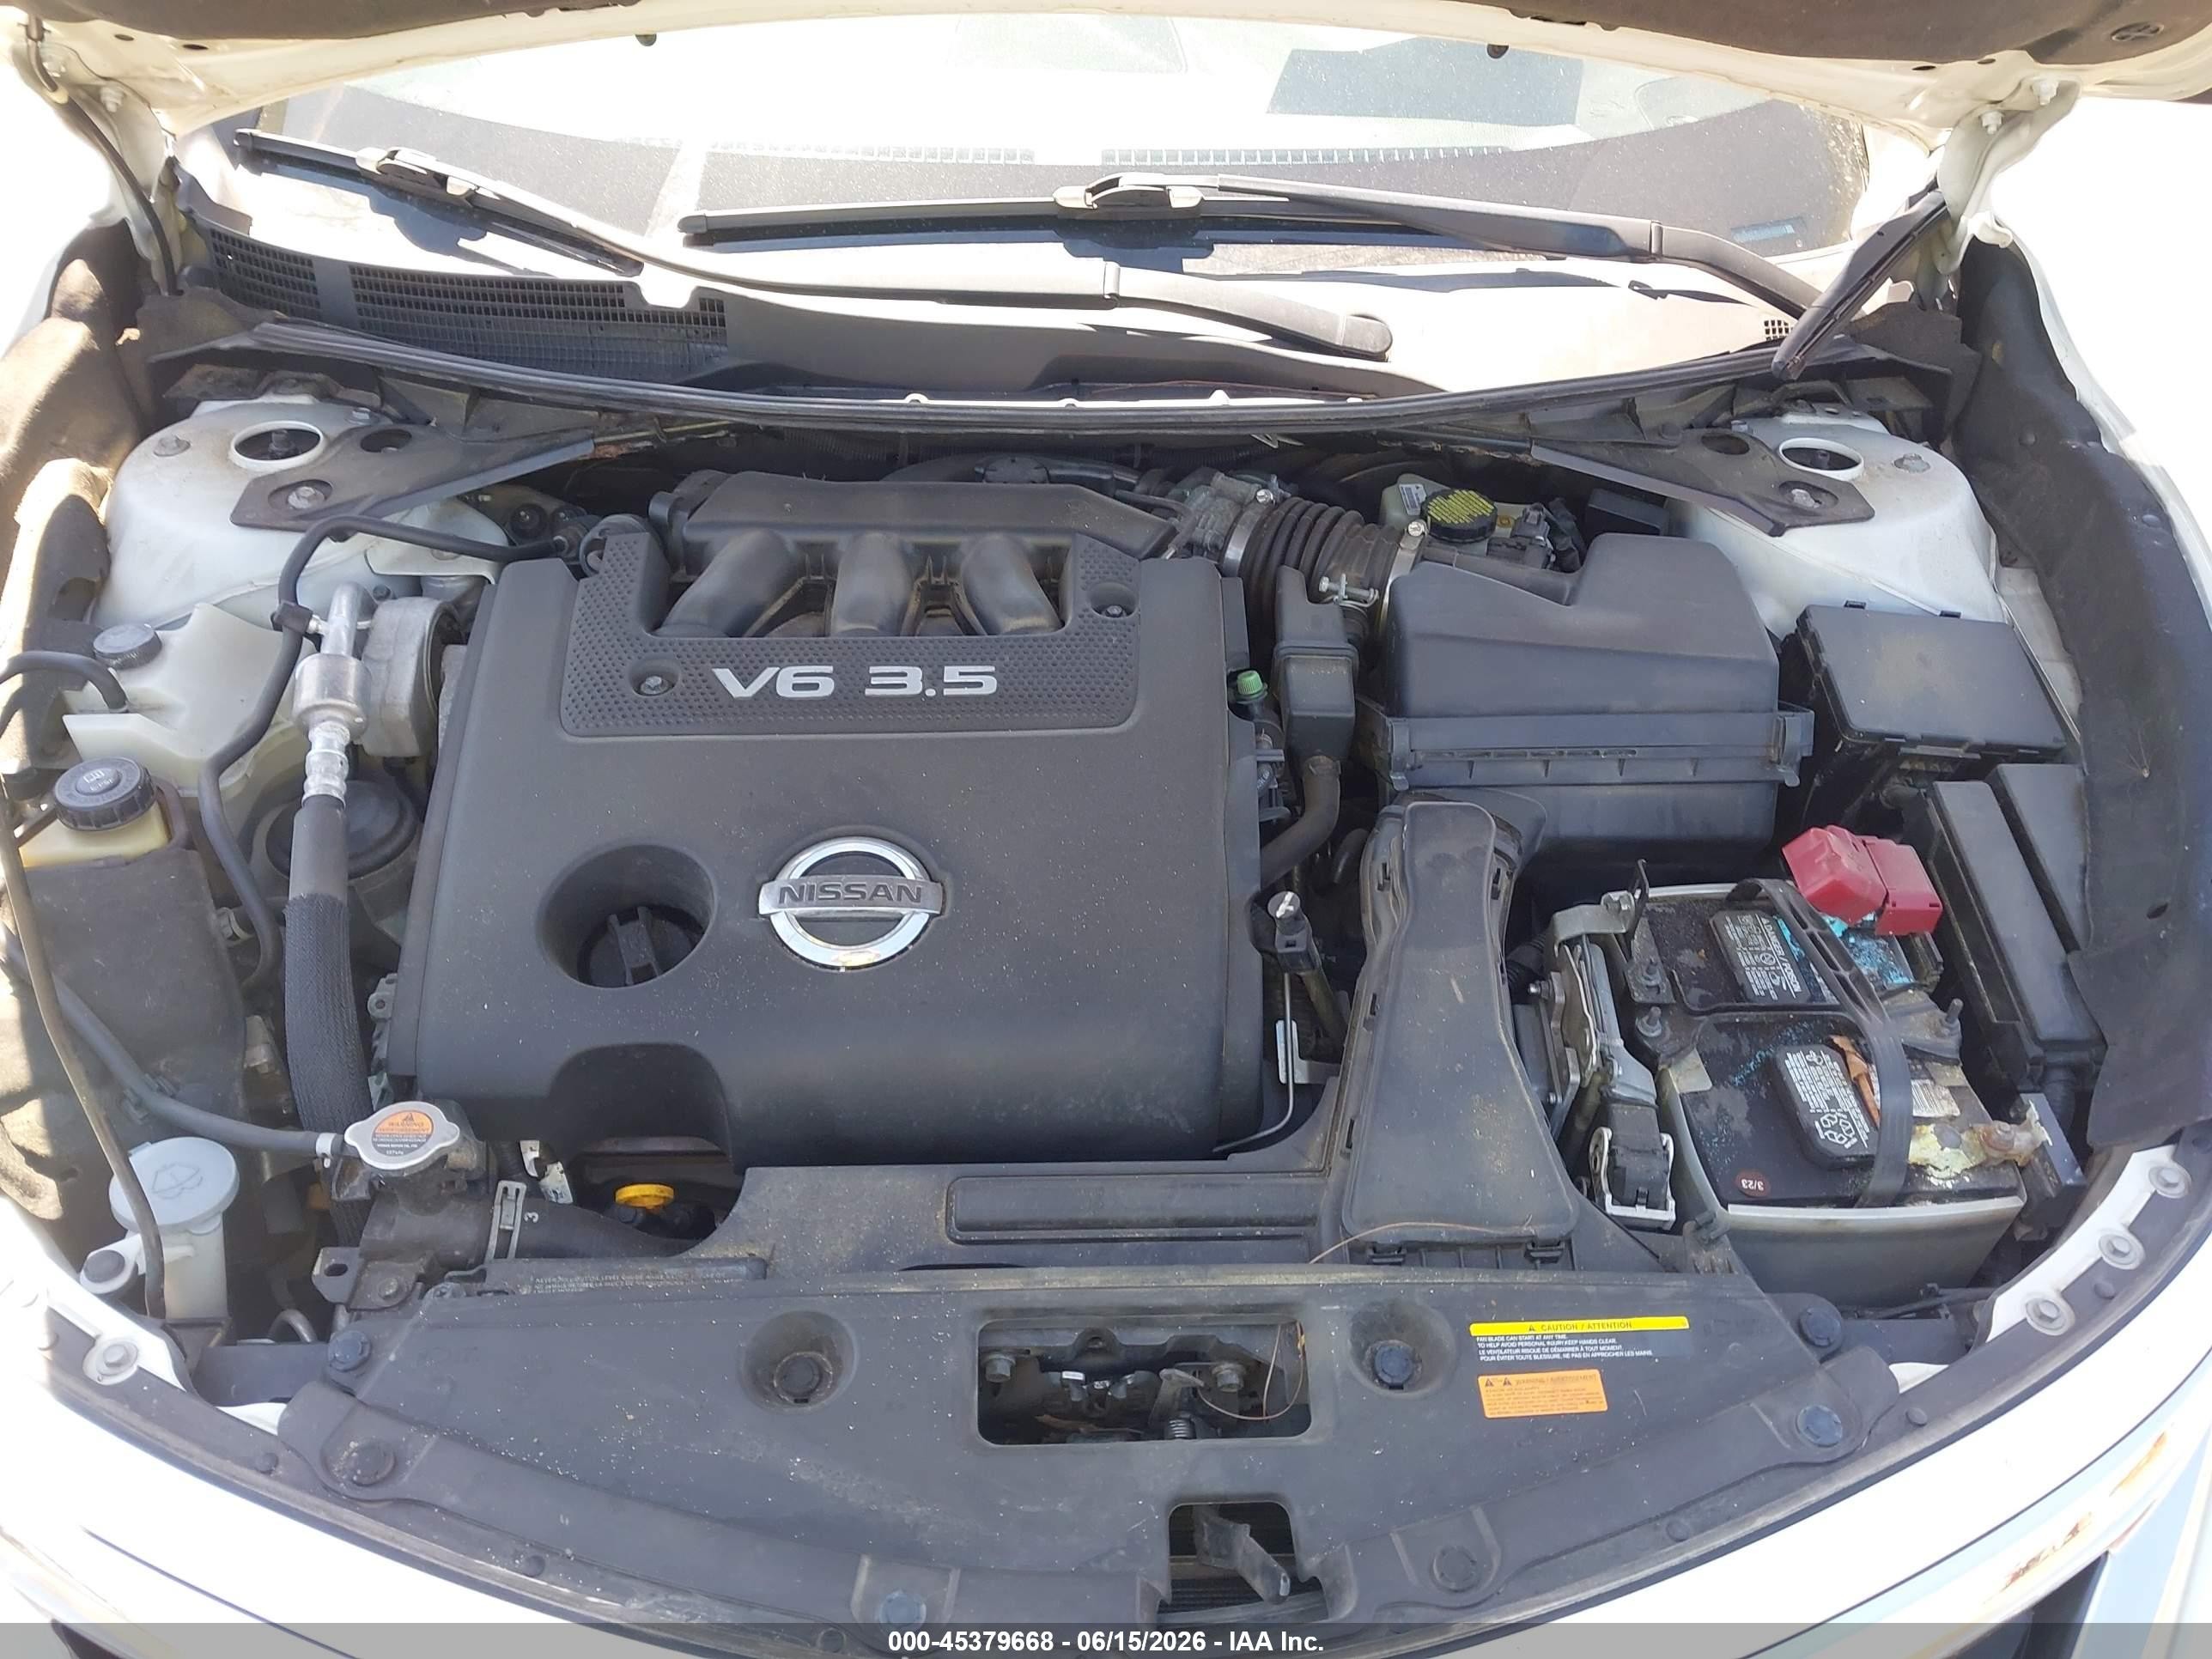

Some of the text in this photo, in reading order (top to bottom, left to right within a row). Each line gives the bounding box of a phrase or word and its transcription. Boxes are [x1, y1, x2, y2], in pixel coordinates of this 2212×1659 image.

[712, 665, 998, 699] V6 3.5
[778, 881, 922, 904] NISSAN
[1741, 1178, 1765, 1192] 3/23
[523, 1212, 539, 1223] 3
[1587, 1322, 1632, 1330] ATTENTION
